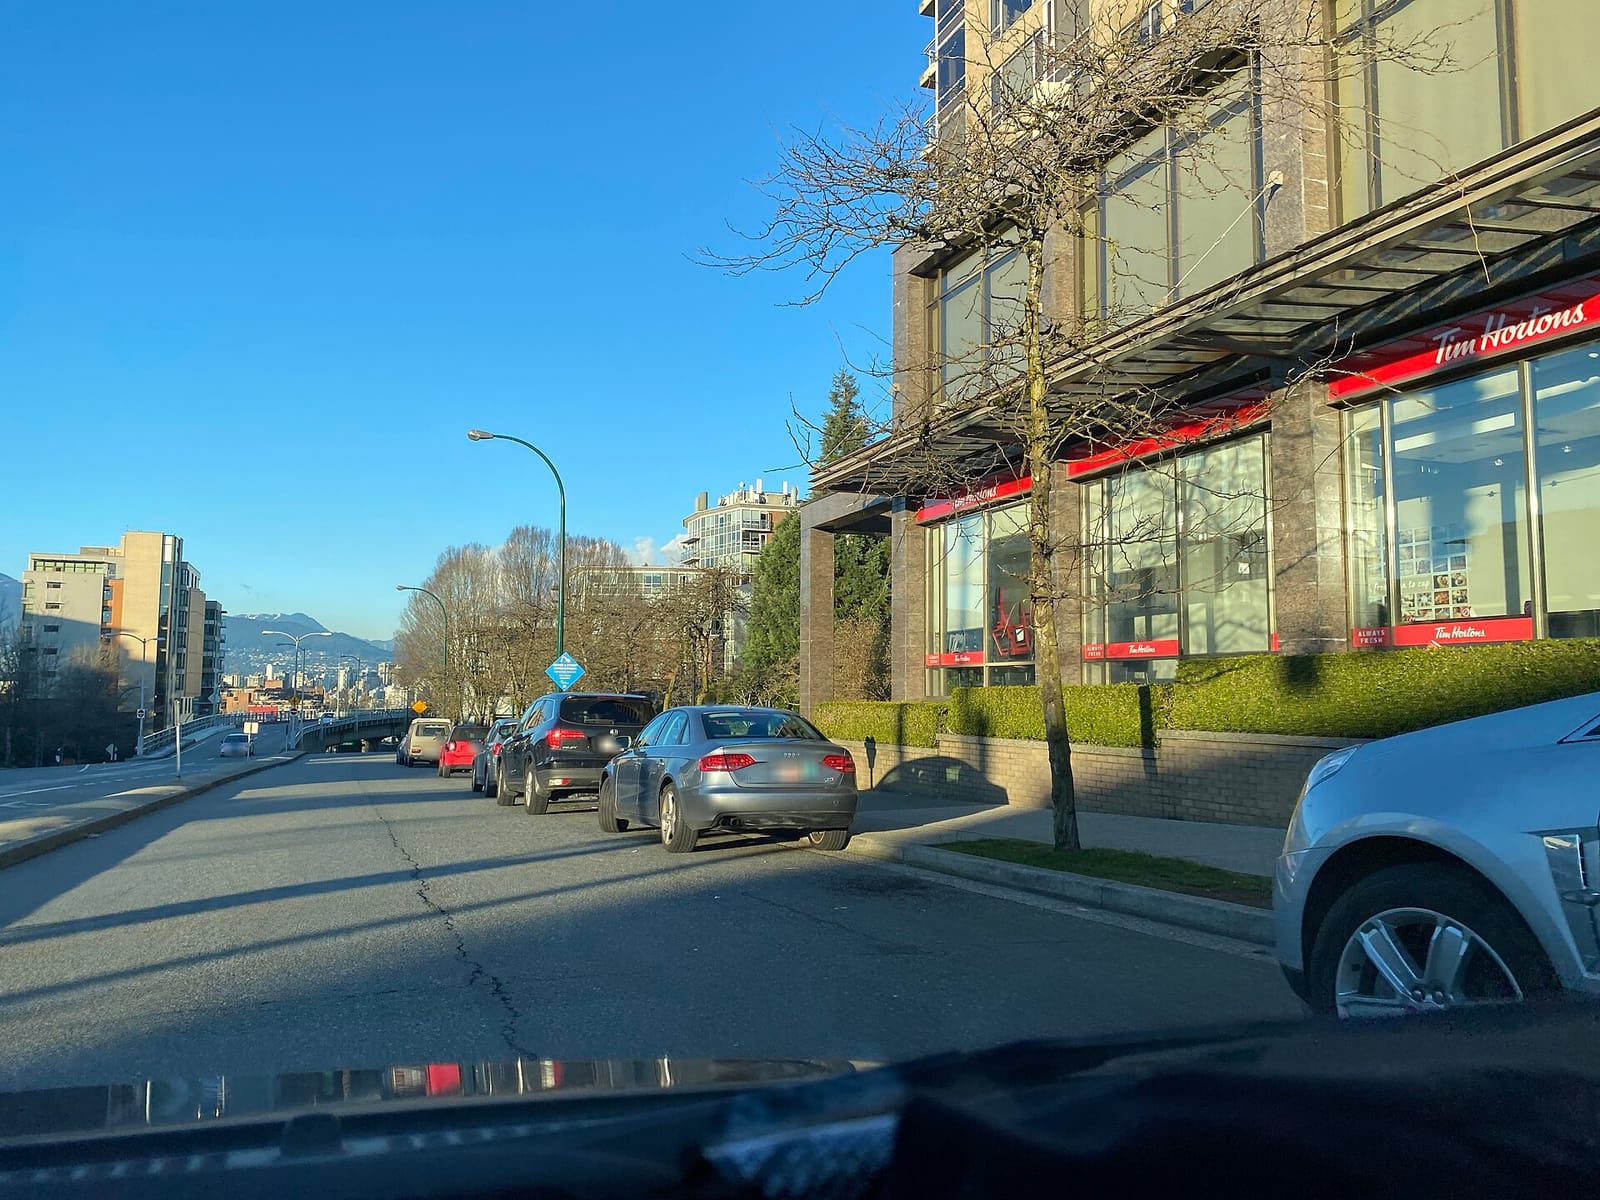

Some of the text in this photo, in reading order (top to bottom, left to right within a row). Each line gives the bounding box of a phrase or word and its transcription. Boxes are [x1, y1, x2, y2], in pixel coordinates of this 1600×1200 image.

[1432, 303, 1584, 364] Tim Hortons
[1358, 629, 1385, 637] ALWAYS
[1435, 625, 1485, 639] Tim Hortons
